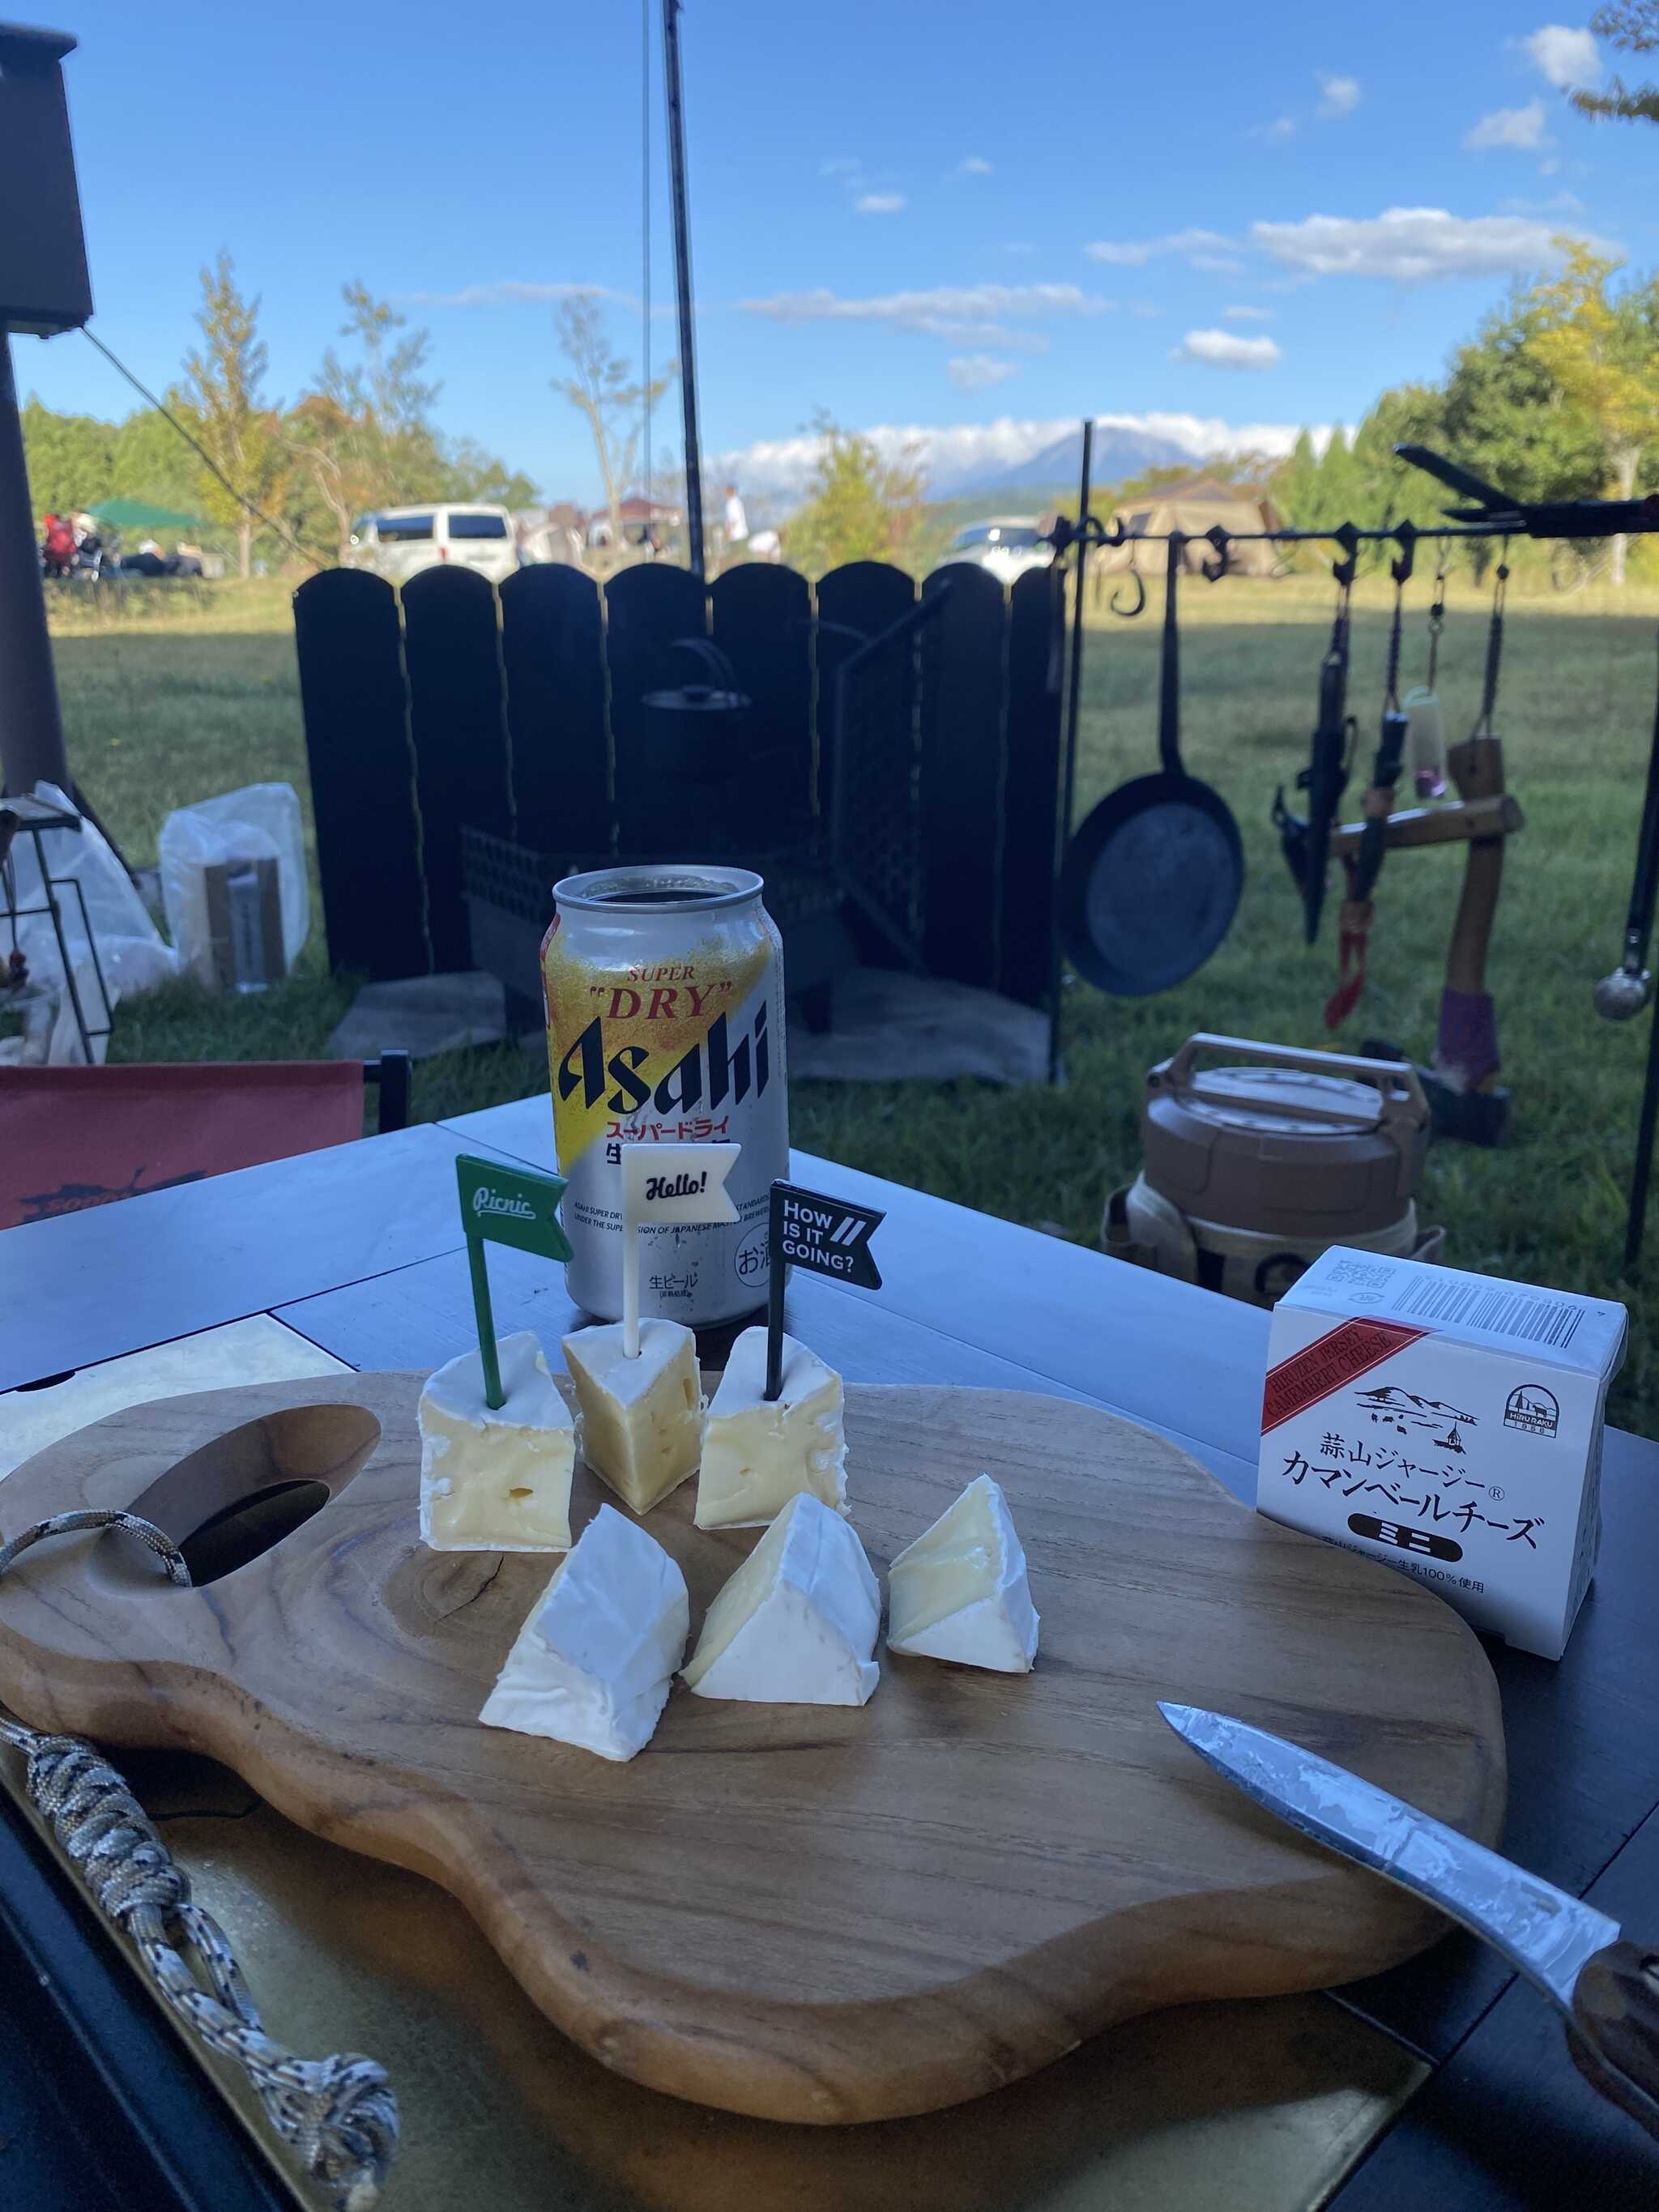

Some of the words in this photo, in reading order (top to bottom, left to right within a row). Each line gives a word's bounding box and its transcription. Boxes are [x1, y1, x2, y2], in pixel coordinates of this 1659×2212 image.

[627, 966, 696, 982] SUPER
[558, 999, 770, 1115] Asahi
[607, 1115, 730, 1141] スーパードライ
[646, 1171, 707, 1200] Hello!
[472, 1187, 536, 1220] Picnic
[589, 1207, 609, 1218] SUPER
[784, 1200, 833, 1230] HOW
[592, 1219, 606, 1230] THE
[658, 1226, 669, 1234] OF
[670, 1222, 712, 1234] JAPANESE
[783, 1221, 800, 1238] IS
[806, 1227, 824, 1245] IT
[783, 1239, 854, 1273] GOING?
[649, 1273, 698, 1289] 生ビール
[1266, 1362, 1340, 1417] CAMEMBERT
[1338, 1331, 1392, 1373] CHEESE
[1270, 1353, 1319, 1394] HIRUZEN
[1319, 1327, 1362, 1362] JERSEY
[1282, 1451, 1546, 1549] カマンベールチーズ
[1378, 1521, 1432, 1554] ミニ
